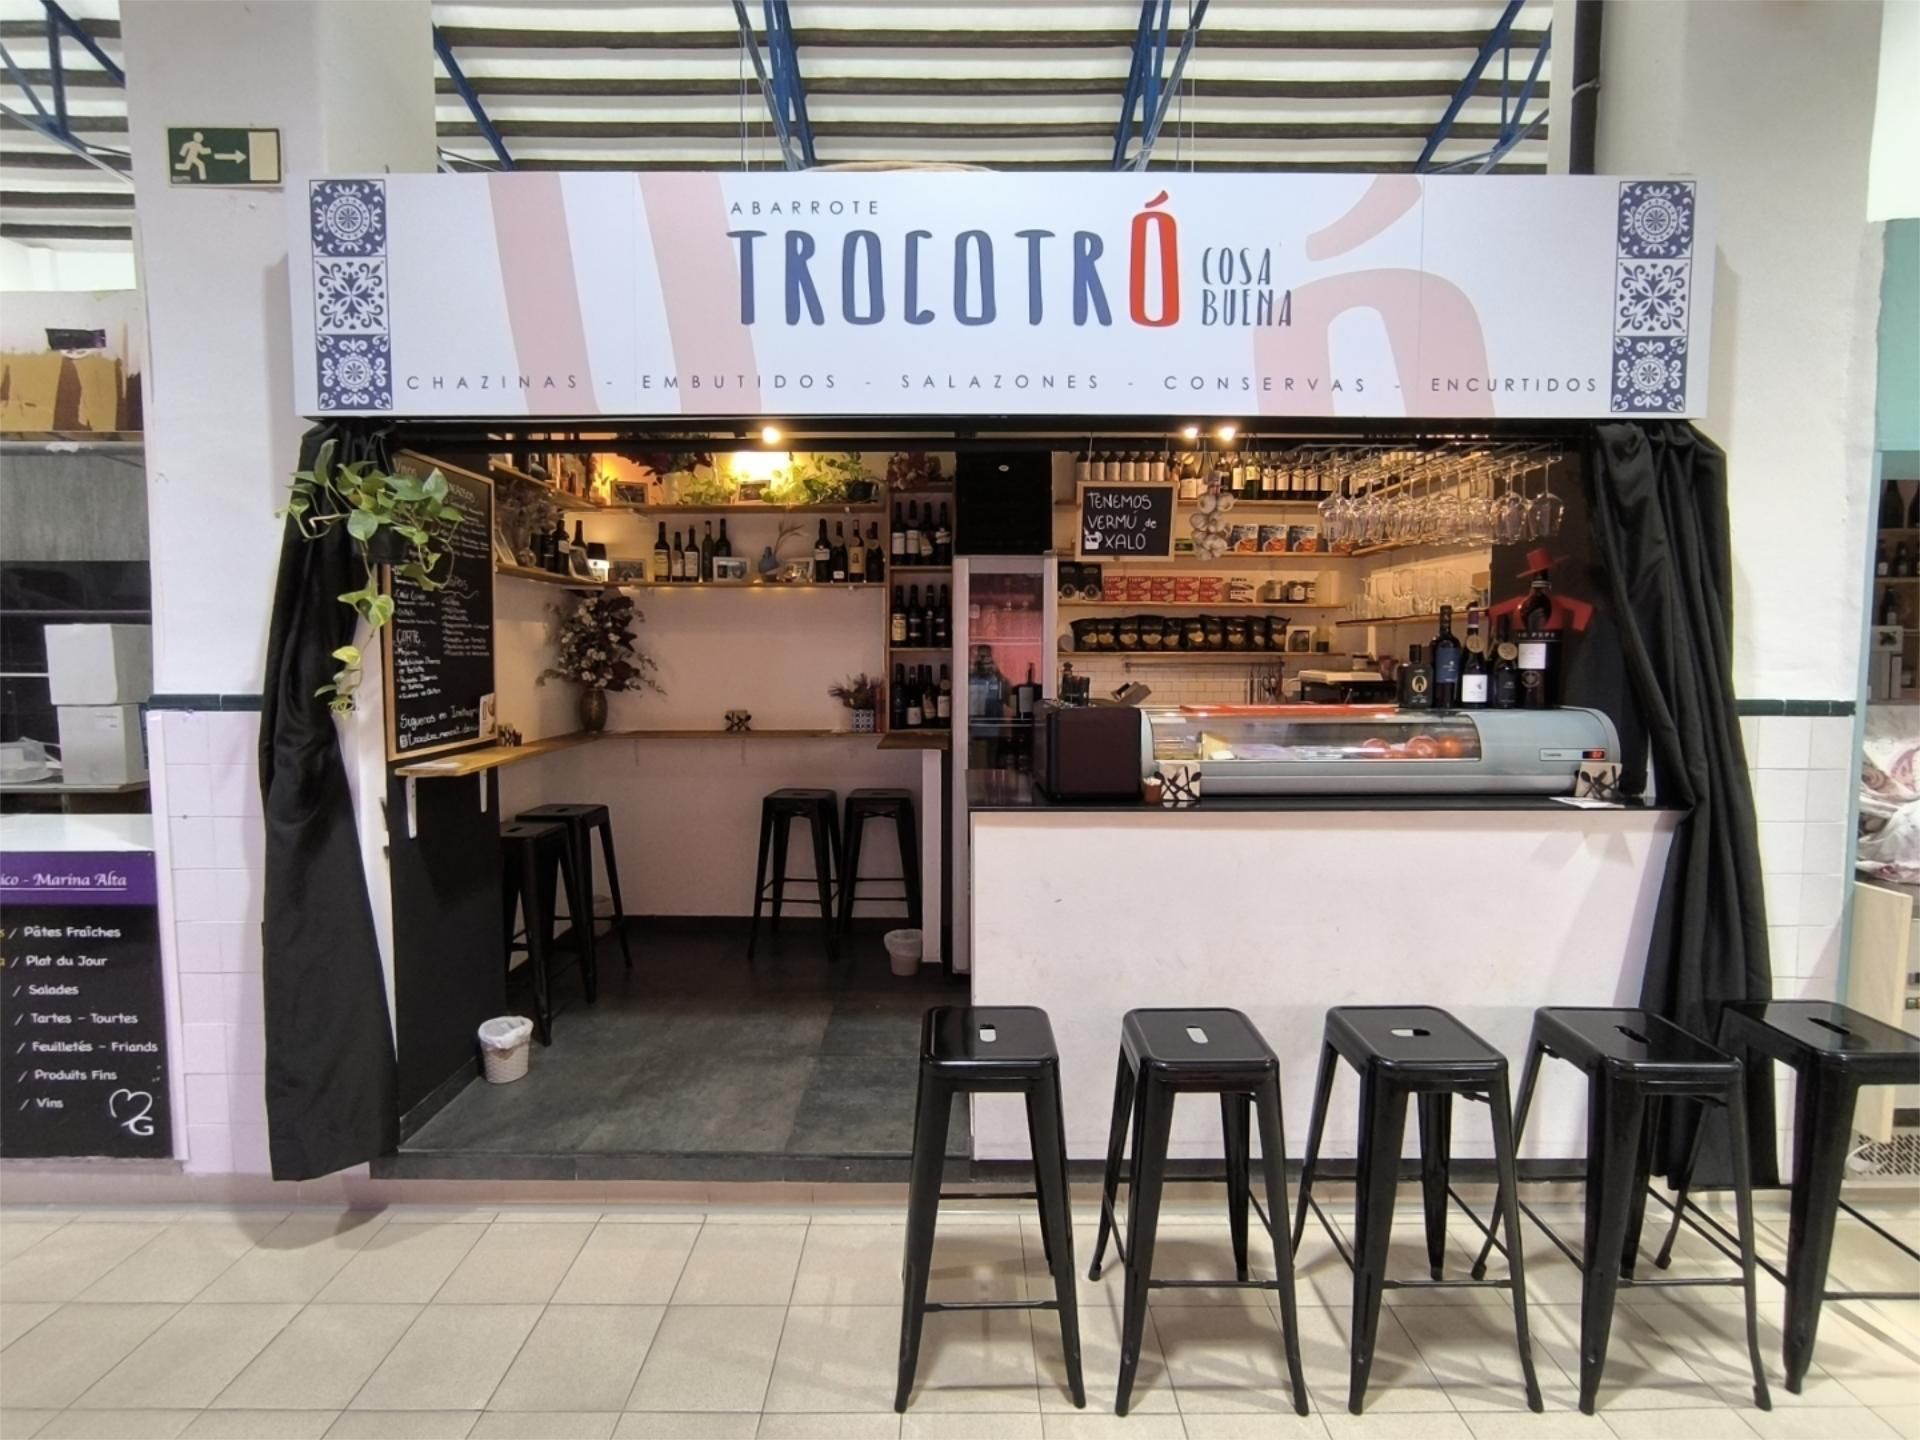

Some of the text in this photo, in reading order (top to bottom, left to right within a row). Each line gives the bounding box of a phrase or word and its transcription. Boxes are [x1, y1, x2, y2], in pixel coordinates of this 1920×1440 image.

[730, 201, 879, 216] ABARROTE
[726, 189, 1180, 328] TROCOTRÓ
[1202, 247, 1272, 286] COSA
[1201, 288, 1293, 328] BUENA
[406, 375, 578, 390] CHAZINAS
[642, 375, 836, 389] EMBUTIDOS
[901, 375, 1099, 389] SALAZONES
[1163, 376, 1366, 392] CONSERVAS
[1431, 378, 1597, 392] ENCURTIDOS
[1087, 492, 1152, 510] TENEMOS
[1087, 510, 1157, 530] VERMÚ de
[1104, 527, 1147, 550] XALÓ
[0, 873, 20, 886] íco
[33, 872, 91, 887] Marina
[94, 870, 127, 887] Alta
[24, 926, 63, 938] Pâtes
[66, 925, 122, 938] Fraîches
[25, 955, 52, 967] Plat
[56, 955, 74, 967] du
[78, 955, 109, 967] Jour
[28, 984, 80, 996] Salades
[31, 1012, 73, 1024] Tartes
[90, 1012, 139, 1024] Tourtes
[31, 1040, 93, 1053] Feuilletés
[111, 1041, 159, 1053] Friands
[34, 1069, 88, 1081] Produits
[91, 1069, 118, 1081] Fins
[36, 1097, 64, 1109] Vins
